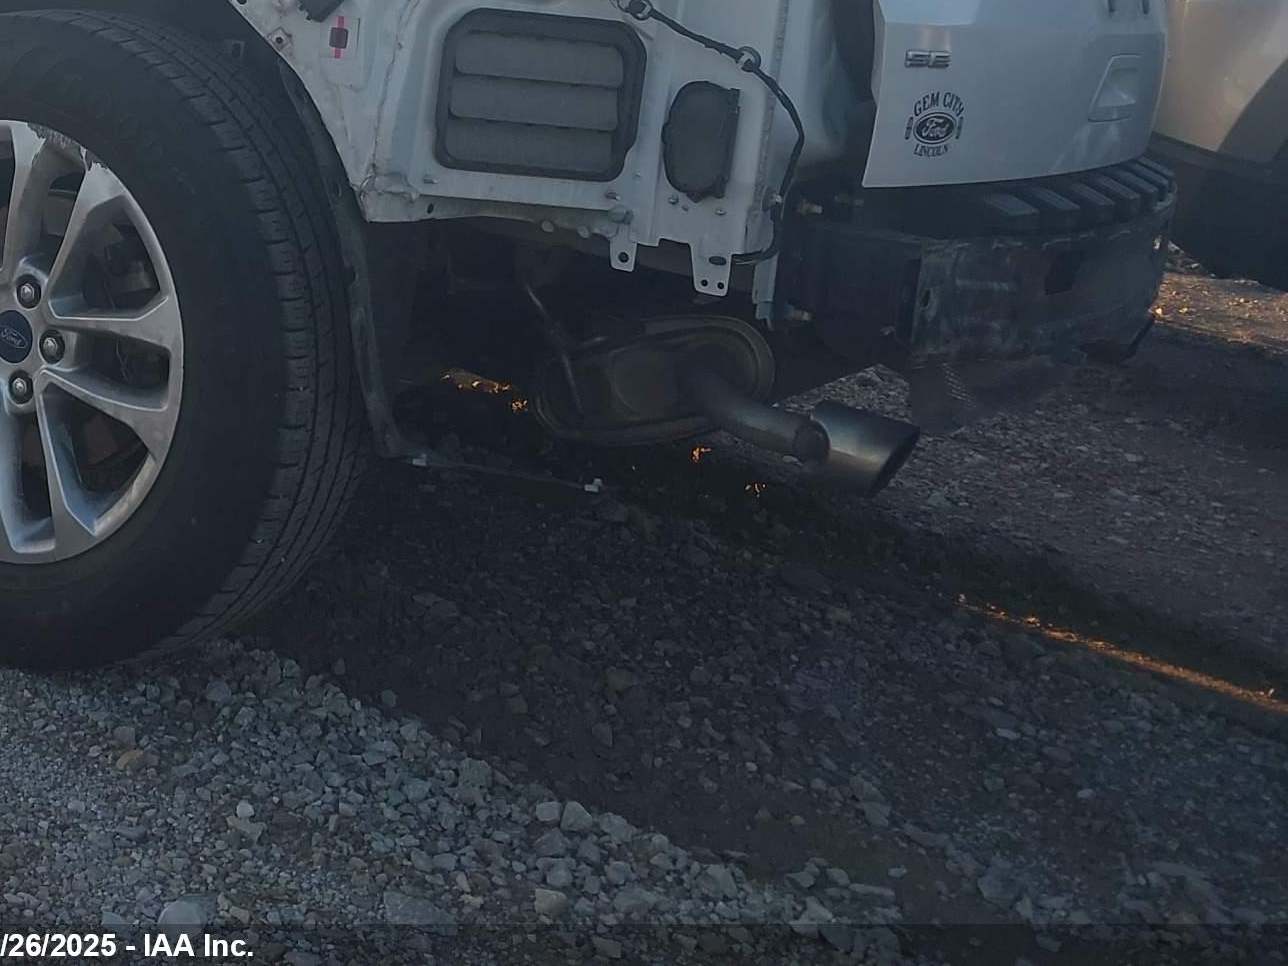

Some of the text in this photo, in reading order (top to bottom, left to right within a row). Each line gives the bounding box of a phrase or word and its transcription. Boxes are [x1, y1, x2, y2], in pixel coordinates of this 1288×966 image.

[905, 49, 951, 68] SE
[914, 91, 965, 117] GEM CITY
[914, 143, 951, 157] LINCOLN
